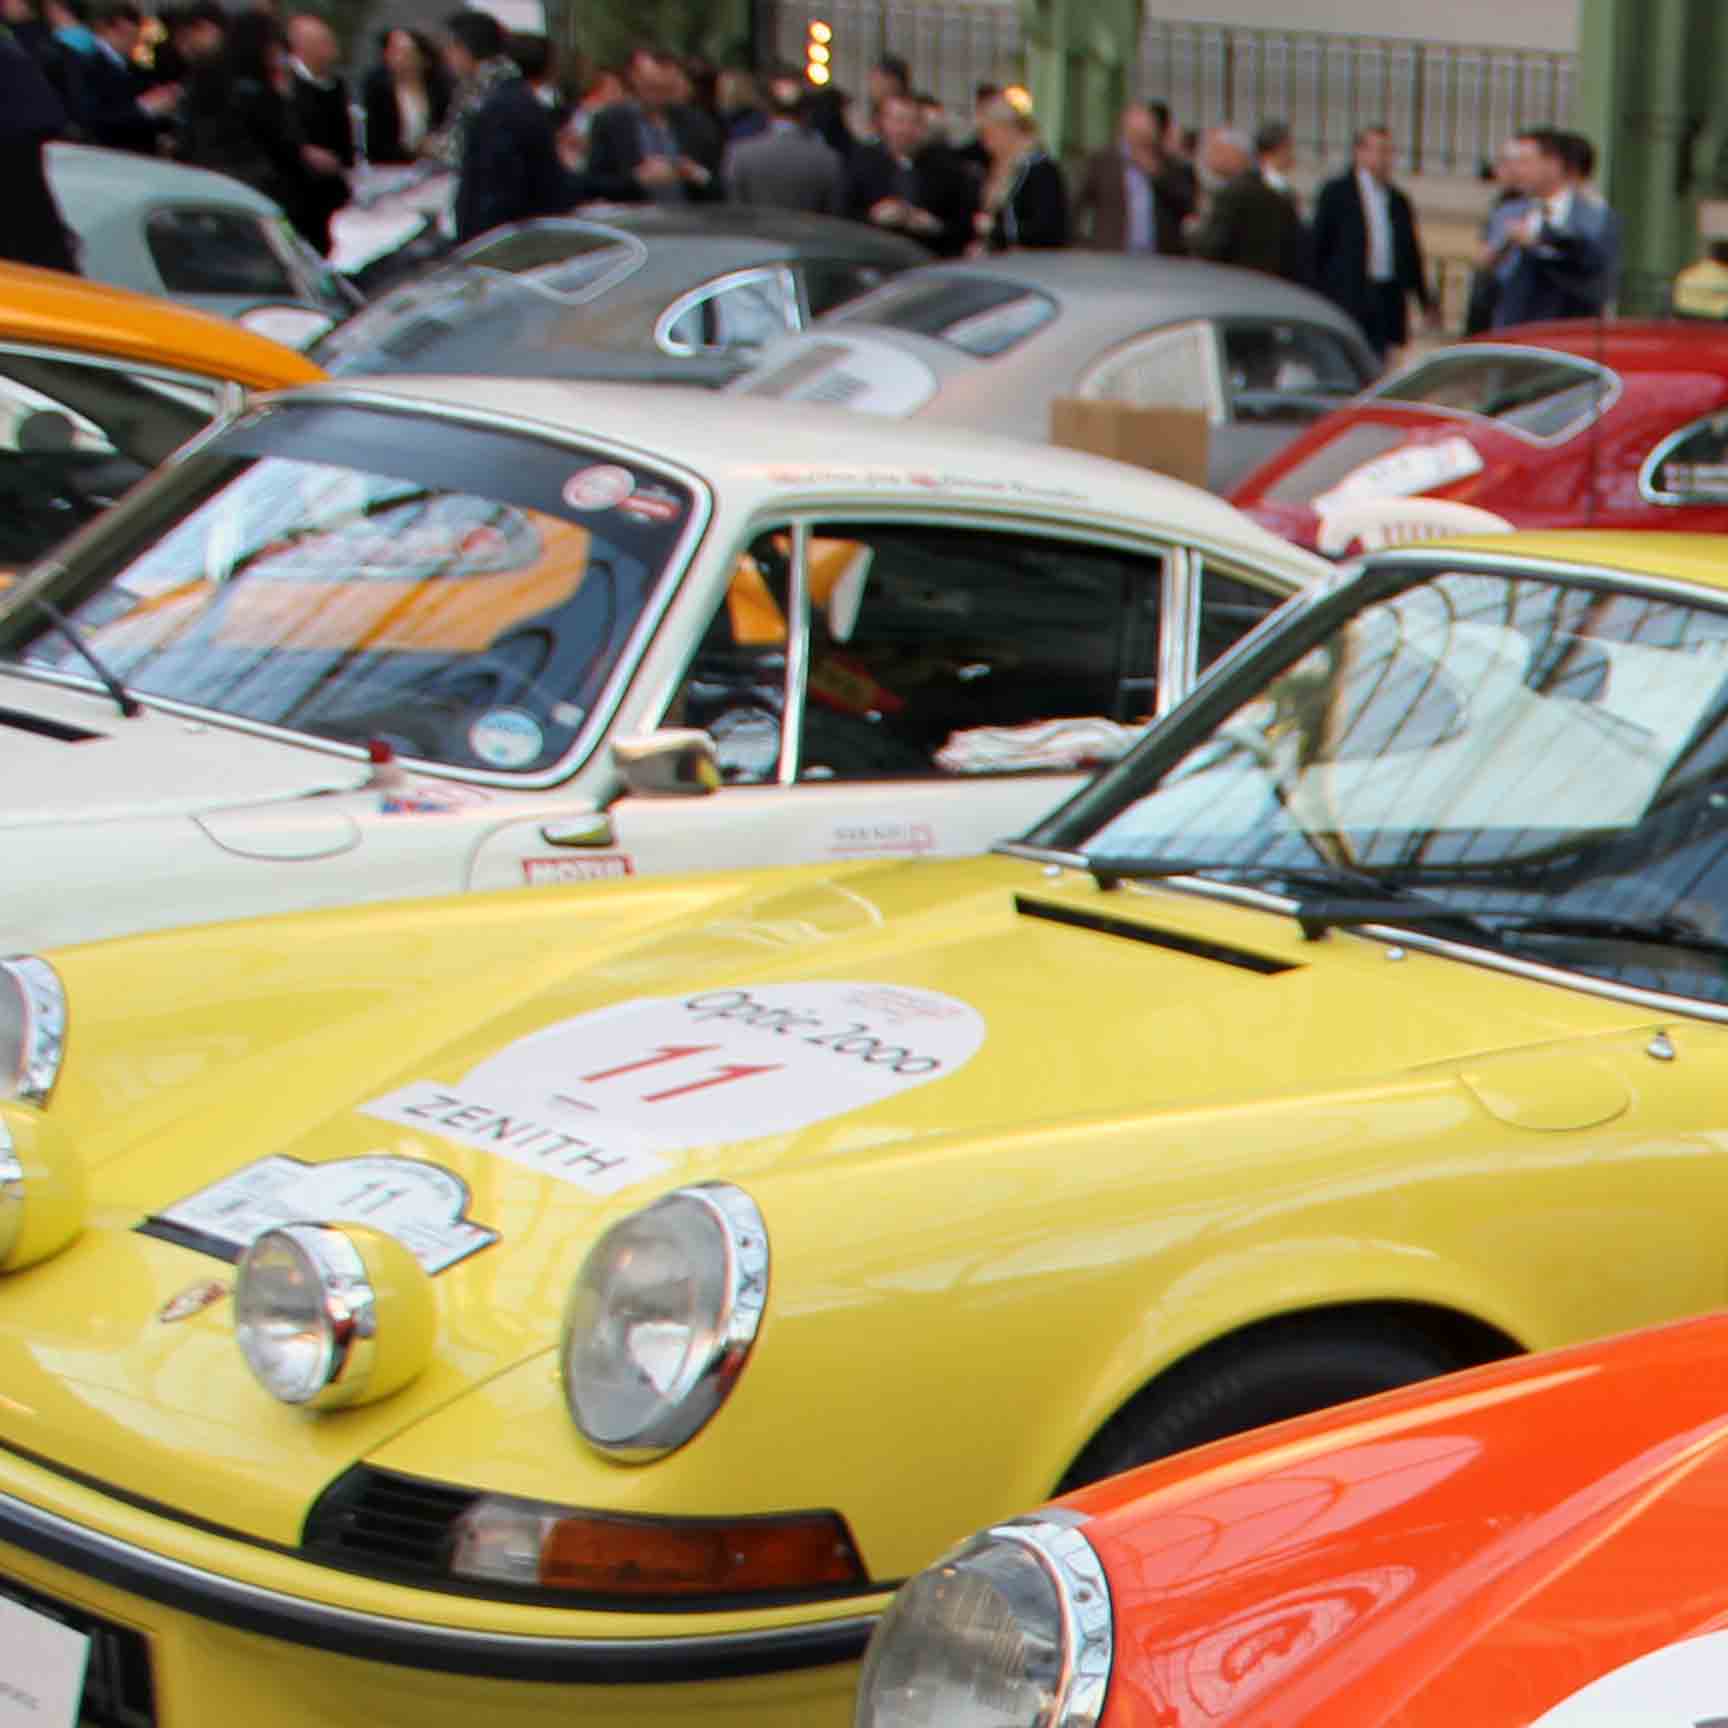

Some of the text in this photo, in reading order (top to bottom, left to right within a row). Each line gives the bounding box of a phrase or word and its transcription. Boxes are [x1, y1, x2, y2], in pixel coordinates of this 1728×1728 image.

[581, 1043, 787, 1103] 11
[683, 990, 822, 1044] Optic
[804, 1022, 942, 1077] 2000
[403, 1093, 627, 1176] ZENITH
